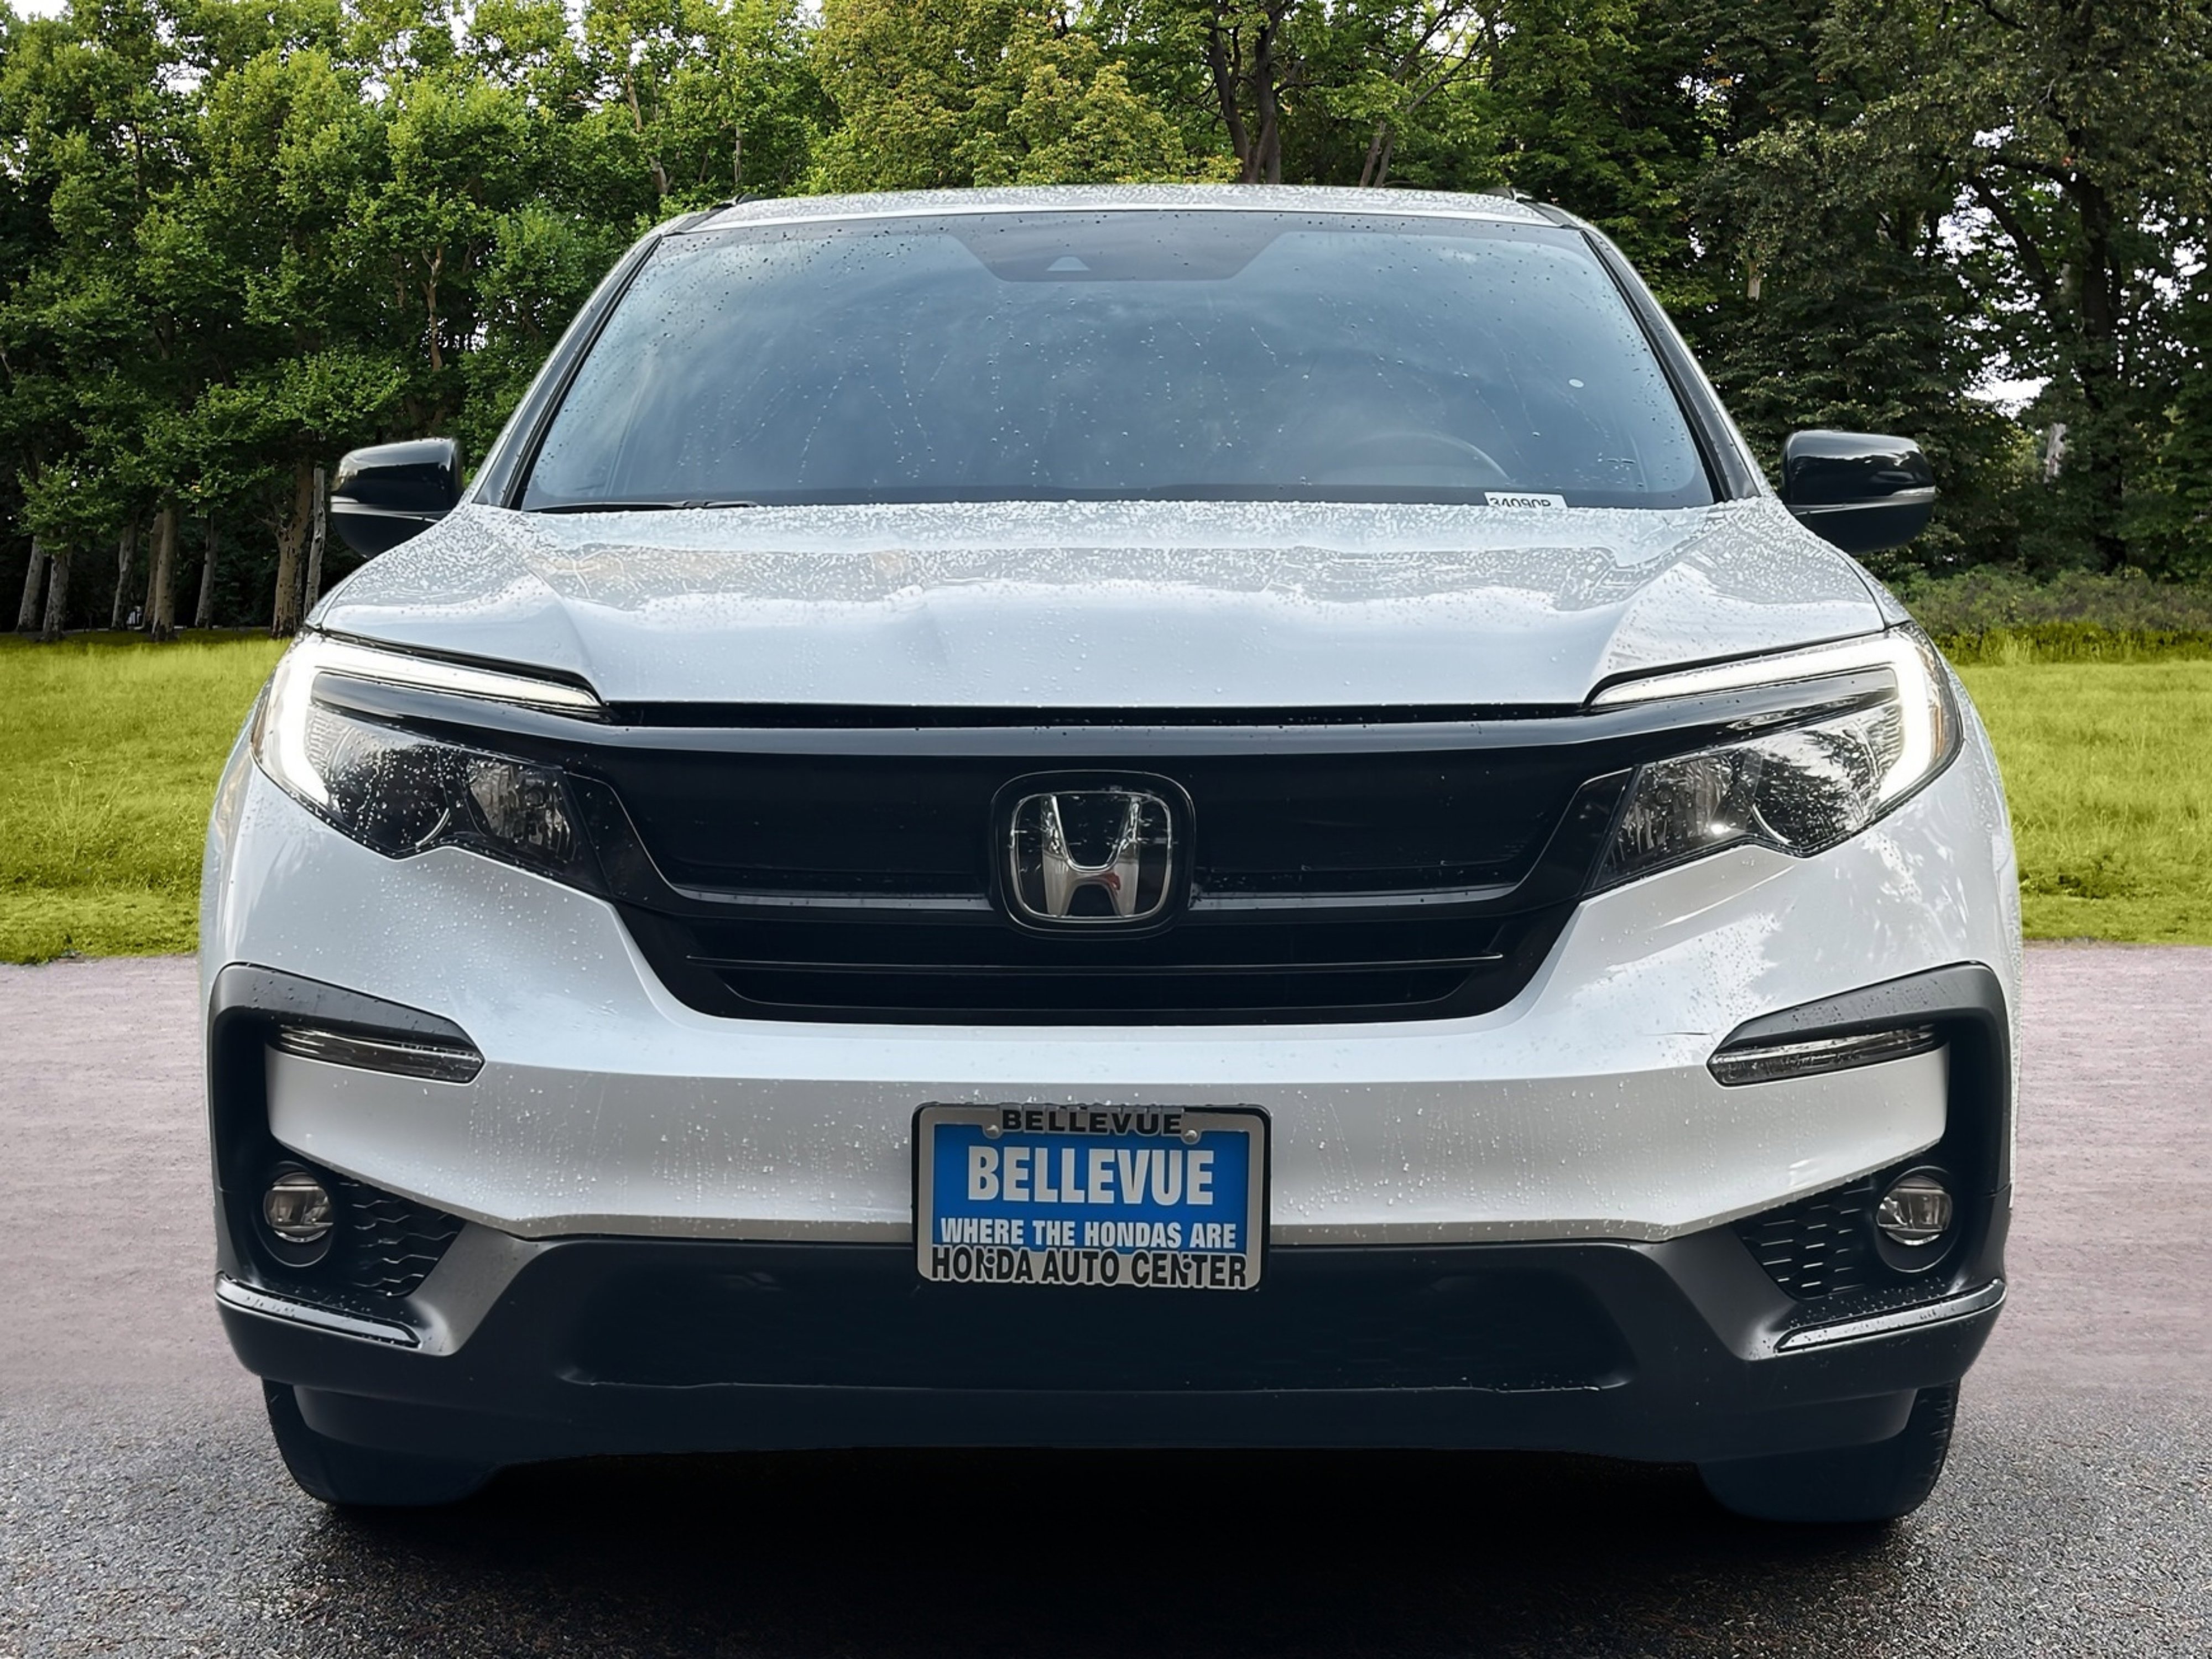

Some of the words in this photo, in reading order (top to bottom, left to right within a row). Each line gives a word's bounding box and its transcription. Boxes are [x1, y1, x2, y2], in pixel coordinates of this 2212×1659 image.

[1002, 1109, 1182, 1135] BELLEVUE
[968, 1145, 1214, 1206] BELLEVUE
[941, 1217, 1024, 1245] WHERE
[1032, 1220, 1075, 1246] THE
[1084, 1221, 1182, 1249] HONDAS
[1190, 1223, 1237, 1249] ARE
[931, 1246, 1034, 1282] HONDA
[1041, 1248, 1120, 1285] AUTO
[1131, 1250, 1247, 1288] CENTER
